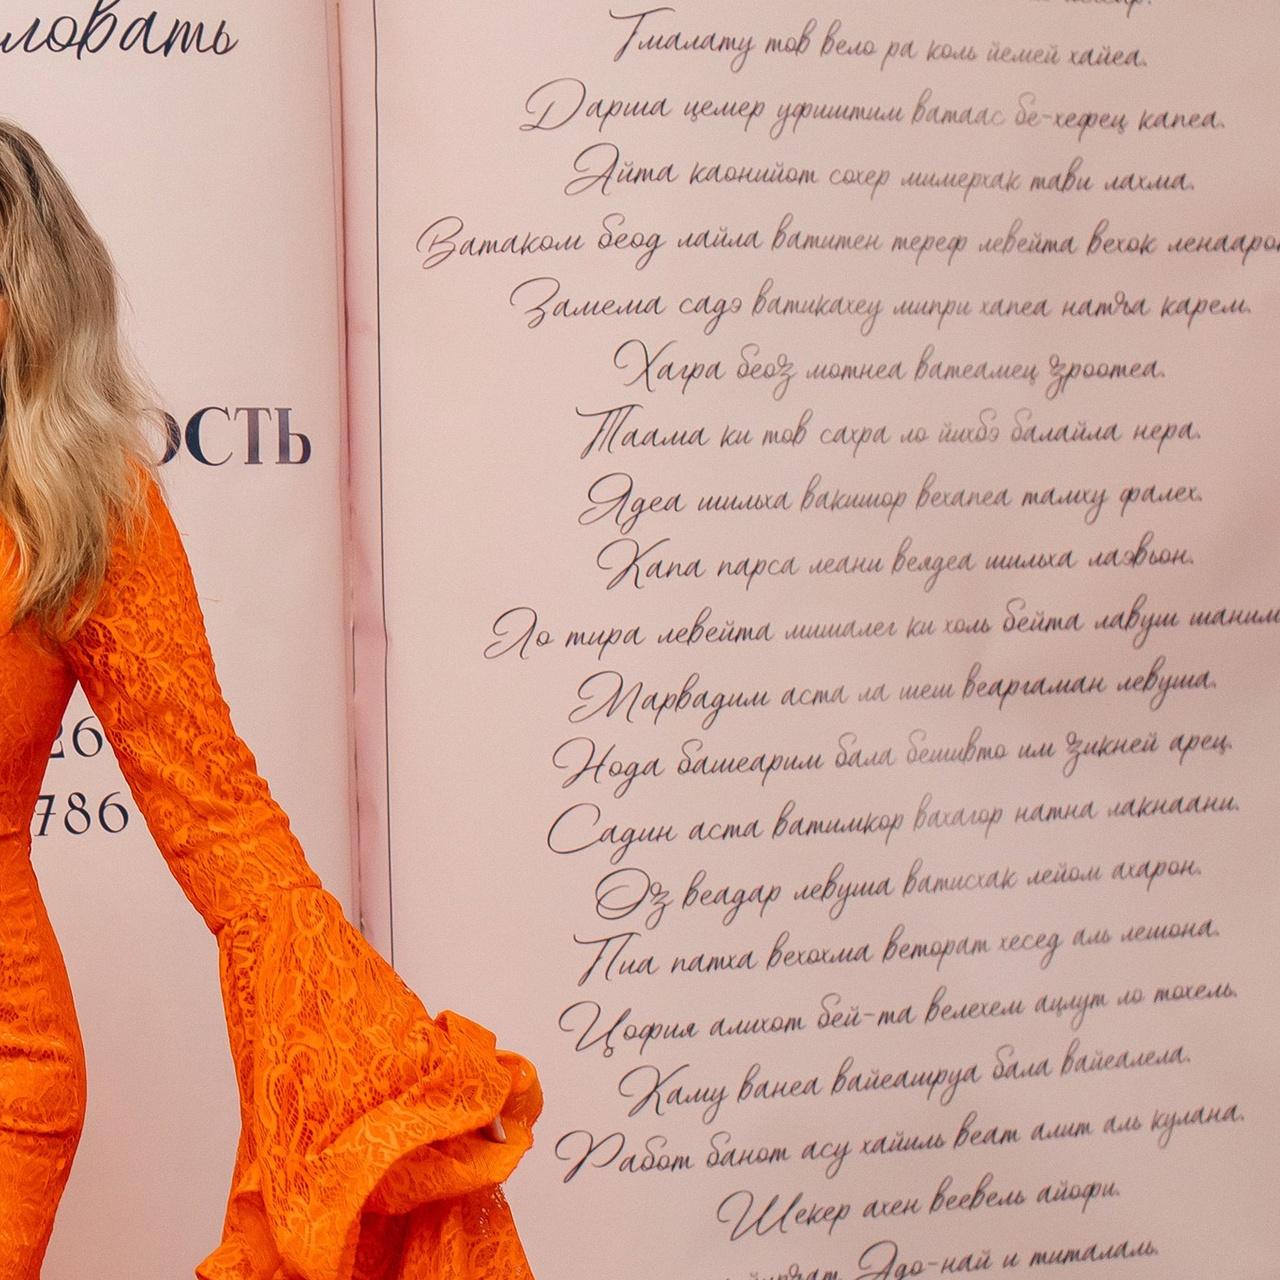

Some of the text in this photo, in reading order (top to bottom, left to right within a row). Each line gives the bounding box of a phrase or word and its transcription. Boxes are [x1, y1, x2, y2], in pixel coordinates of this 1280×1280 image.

[765, 18, 817, 56] тов
[820, 19, 877, 56] вело
[926, 40, 978, 61] коль
[987, 41, 1061, 65] йемей
[1069, 44, 1147, 68] хайеа.
[519, 78, 1225, 140] Дарша цемер уфиштим капеа.
[830, 168, 890, 201] сохер
[1030, 156, 1093, 192] тави
[1104, 172, 1195, 191] лахма.
[416, 212, 1157, 270] Ватаком беод лайла ватитен тереф левейта вехок
[510, 276, 1252, 337] Замема садэ ватикахеу мипри хапеа карем.
[613, 339, 726, 395] Хагра
[737, 343, 794, 401] беоз
[805, 360, 904, 380] мотнеа
[914, 343, 1040, 386] ватеамец
[141, 406, 312, 467] ОСТЬ
[575, 403, 710, 460] Таама
[762, 408, 813, 447] тов
[820, 425, 892, 458] сахра
[1011, 407, 1123, 443] балайла
[1133, 422, 1201, 453] нера.
[578, 472, 687, 535] Ядеа
[915, 472, 1013, 510] вехапеа
[1022, 487, 1109, 525] тамху
[1120, 485, 1203, 517] фалех.
[597, 538, 707, 590] Капа
[717, 556, 798, 591] парса
[565, 625, 646, 661] тира
[657, 606, 773, 646] левейта
[944, 617, 991, 634] холь
[1002, 597, 1085, 633] бейта
[1094, 593, 1179, 650] лавуш
[569, 655, 1217, 731] Марвадим аста шеш веаргаман левуша.
[552, 730, 1232, 799] Нода башеарим бала зикней арец.
[34, 791, 129, 836] 786
[547, 792, 1240, 865] Садин аста ватимкор вахагор натна лакнаани.
[595, 868, 673, 930] Оз
[682, 870, 782, 926] веадар
[794, 862, 895, 920] левуша
[1027, 862, 1103, 886] лейом
[1111, 860, 1201, 892] ахарон.
[574, 919, 1219, 986] Пиа патха вехохма веторат хесед лешона.
[558, 1001, 699, 1057] Цофия
[710, 1016, 806, 1037] алихот
[924, 985, 1024, 1025] велехем
[1035, 992, 1109, 1031] ацлут
[1154, 982, 1237, 1003] тохель.
[619, 1064, 728, 1124] Каму
[737, 1063, 822, 1103] ванеа
[992, 1044, 1053, 1080] бала
[555, 1104, 1245, 1183] Работ банот асу хайиль веат кулана.
[717, 1172, 1120, 1241] Шекер ахен веевель айофи.
